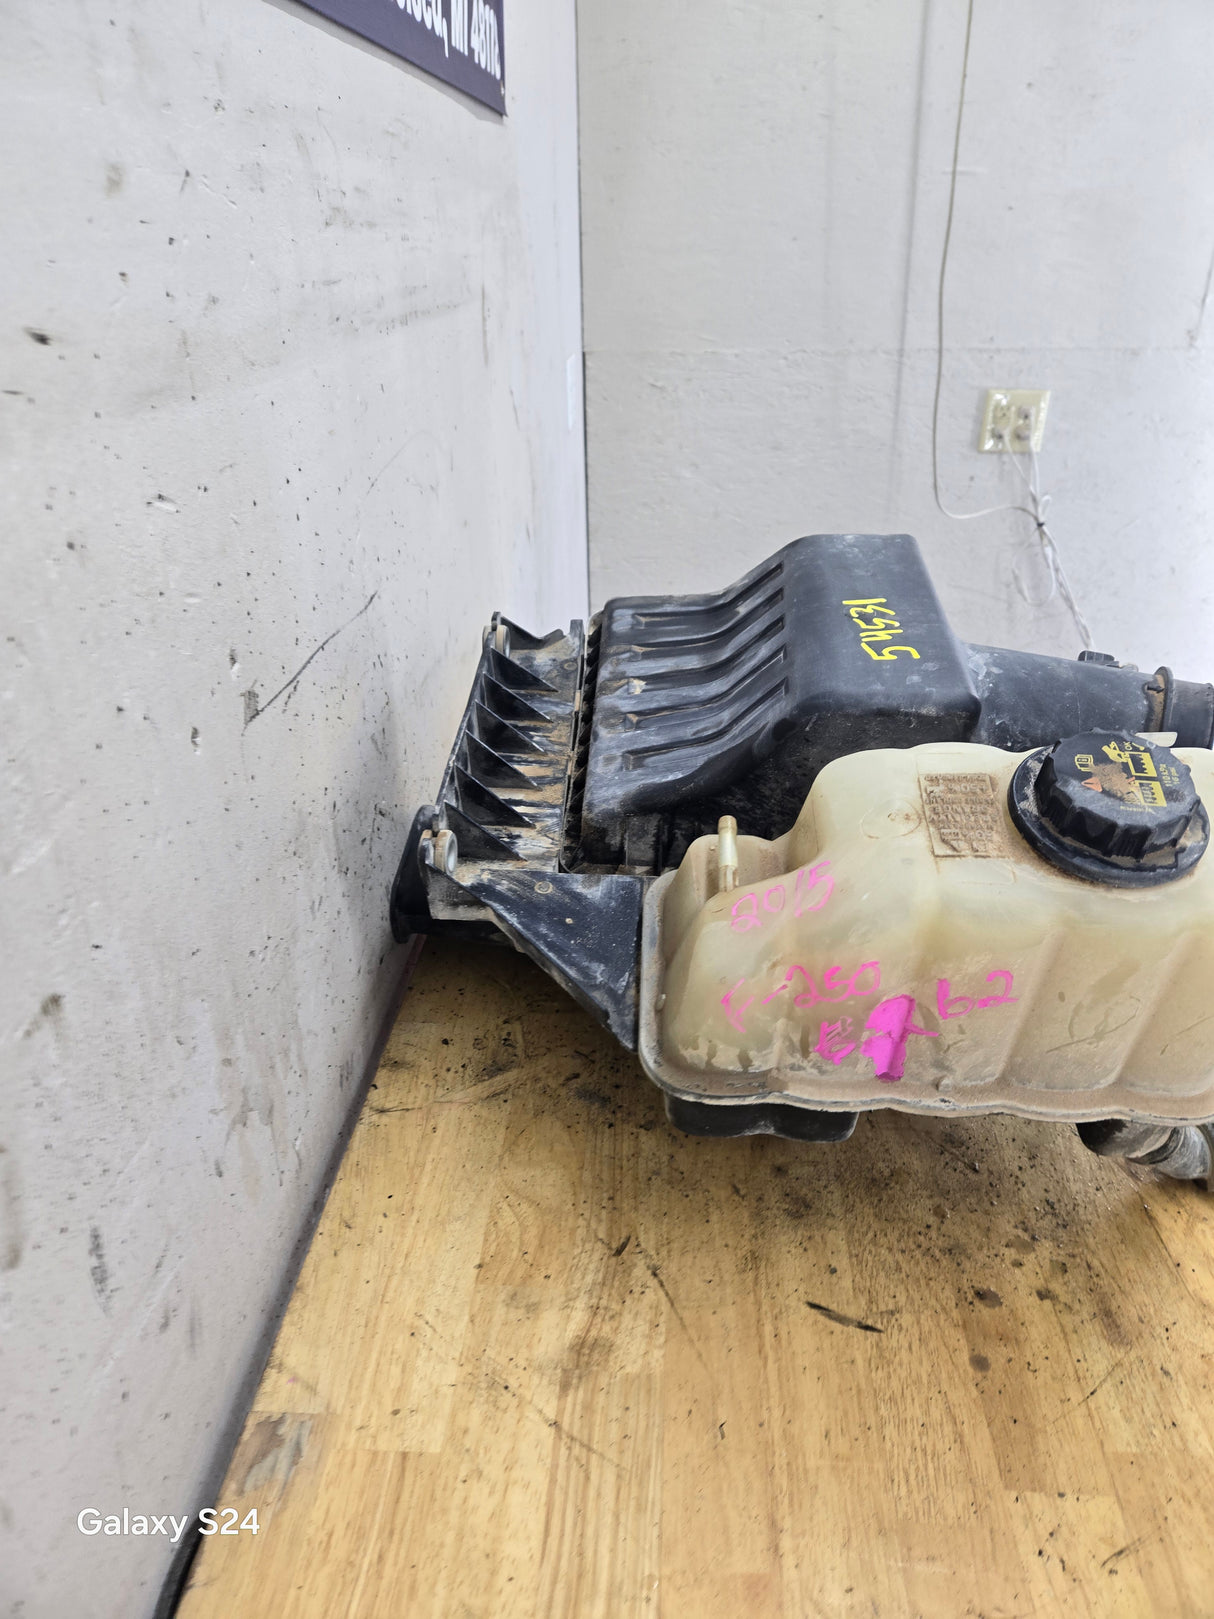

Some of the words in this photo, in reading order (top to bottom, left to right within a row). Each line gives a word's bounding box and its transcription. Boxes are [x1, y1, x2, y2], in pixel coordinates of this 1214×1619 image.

[451, 0, 468, 56] MI
[731, 860, 835, 932] 2015
[720, 961, 881, 1034] F-250
